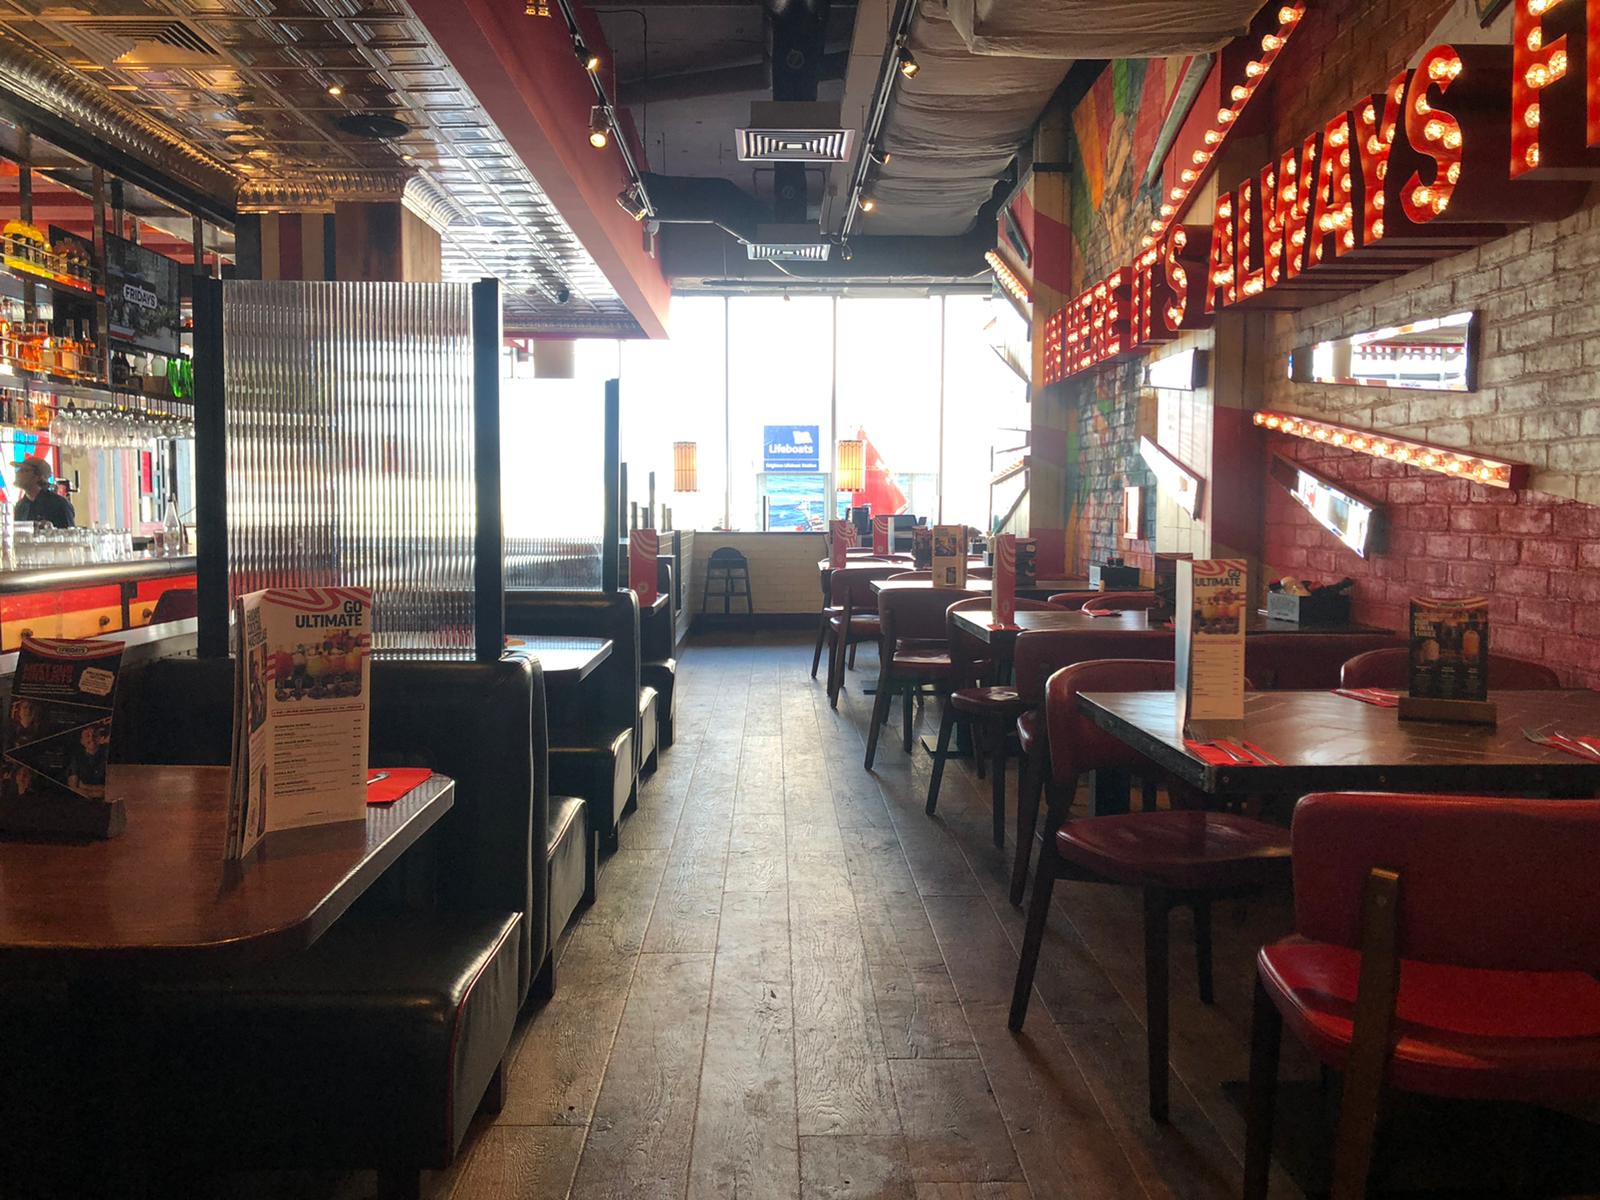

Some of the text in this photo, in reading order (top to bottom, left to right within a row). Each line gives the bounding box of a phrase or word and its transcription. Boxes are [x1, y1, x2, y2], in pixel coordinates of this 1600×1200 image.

[1065, 267, 1121, 378] HERE
[1204, 44, 1463, 314] ALWAYS
[125, 286, 156, 307] FRIDAYS
[768, 444, 814, 454] Lifeboats
[1228, 569, 1240, 577] GO
[1194, 577, 1240, 587] ULTIMATE
[343, 600, 362, 613] GO
[295, 614, 363, 628] ULTIMATE
